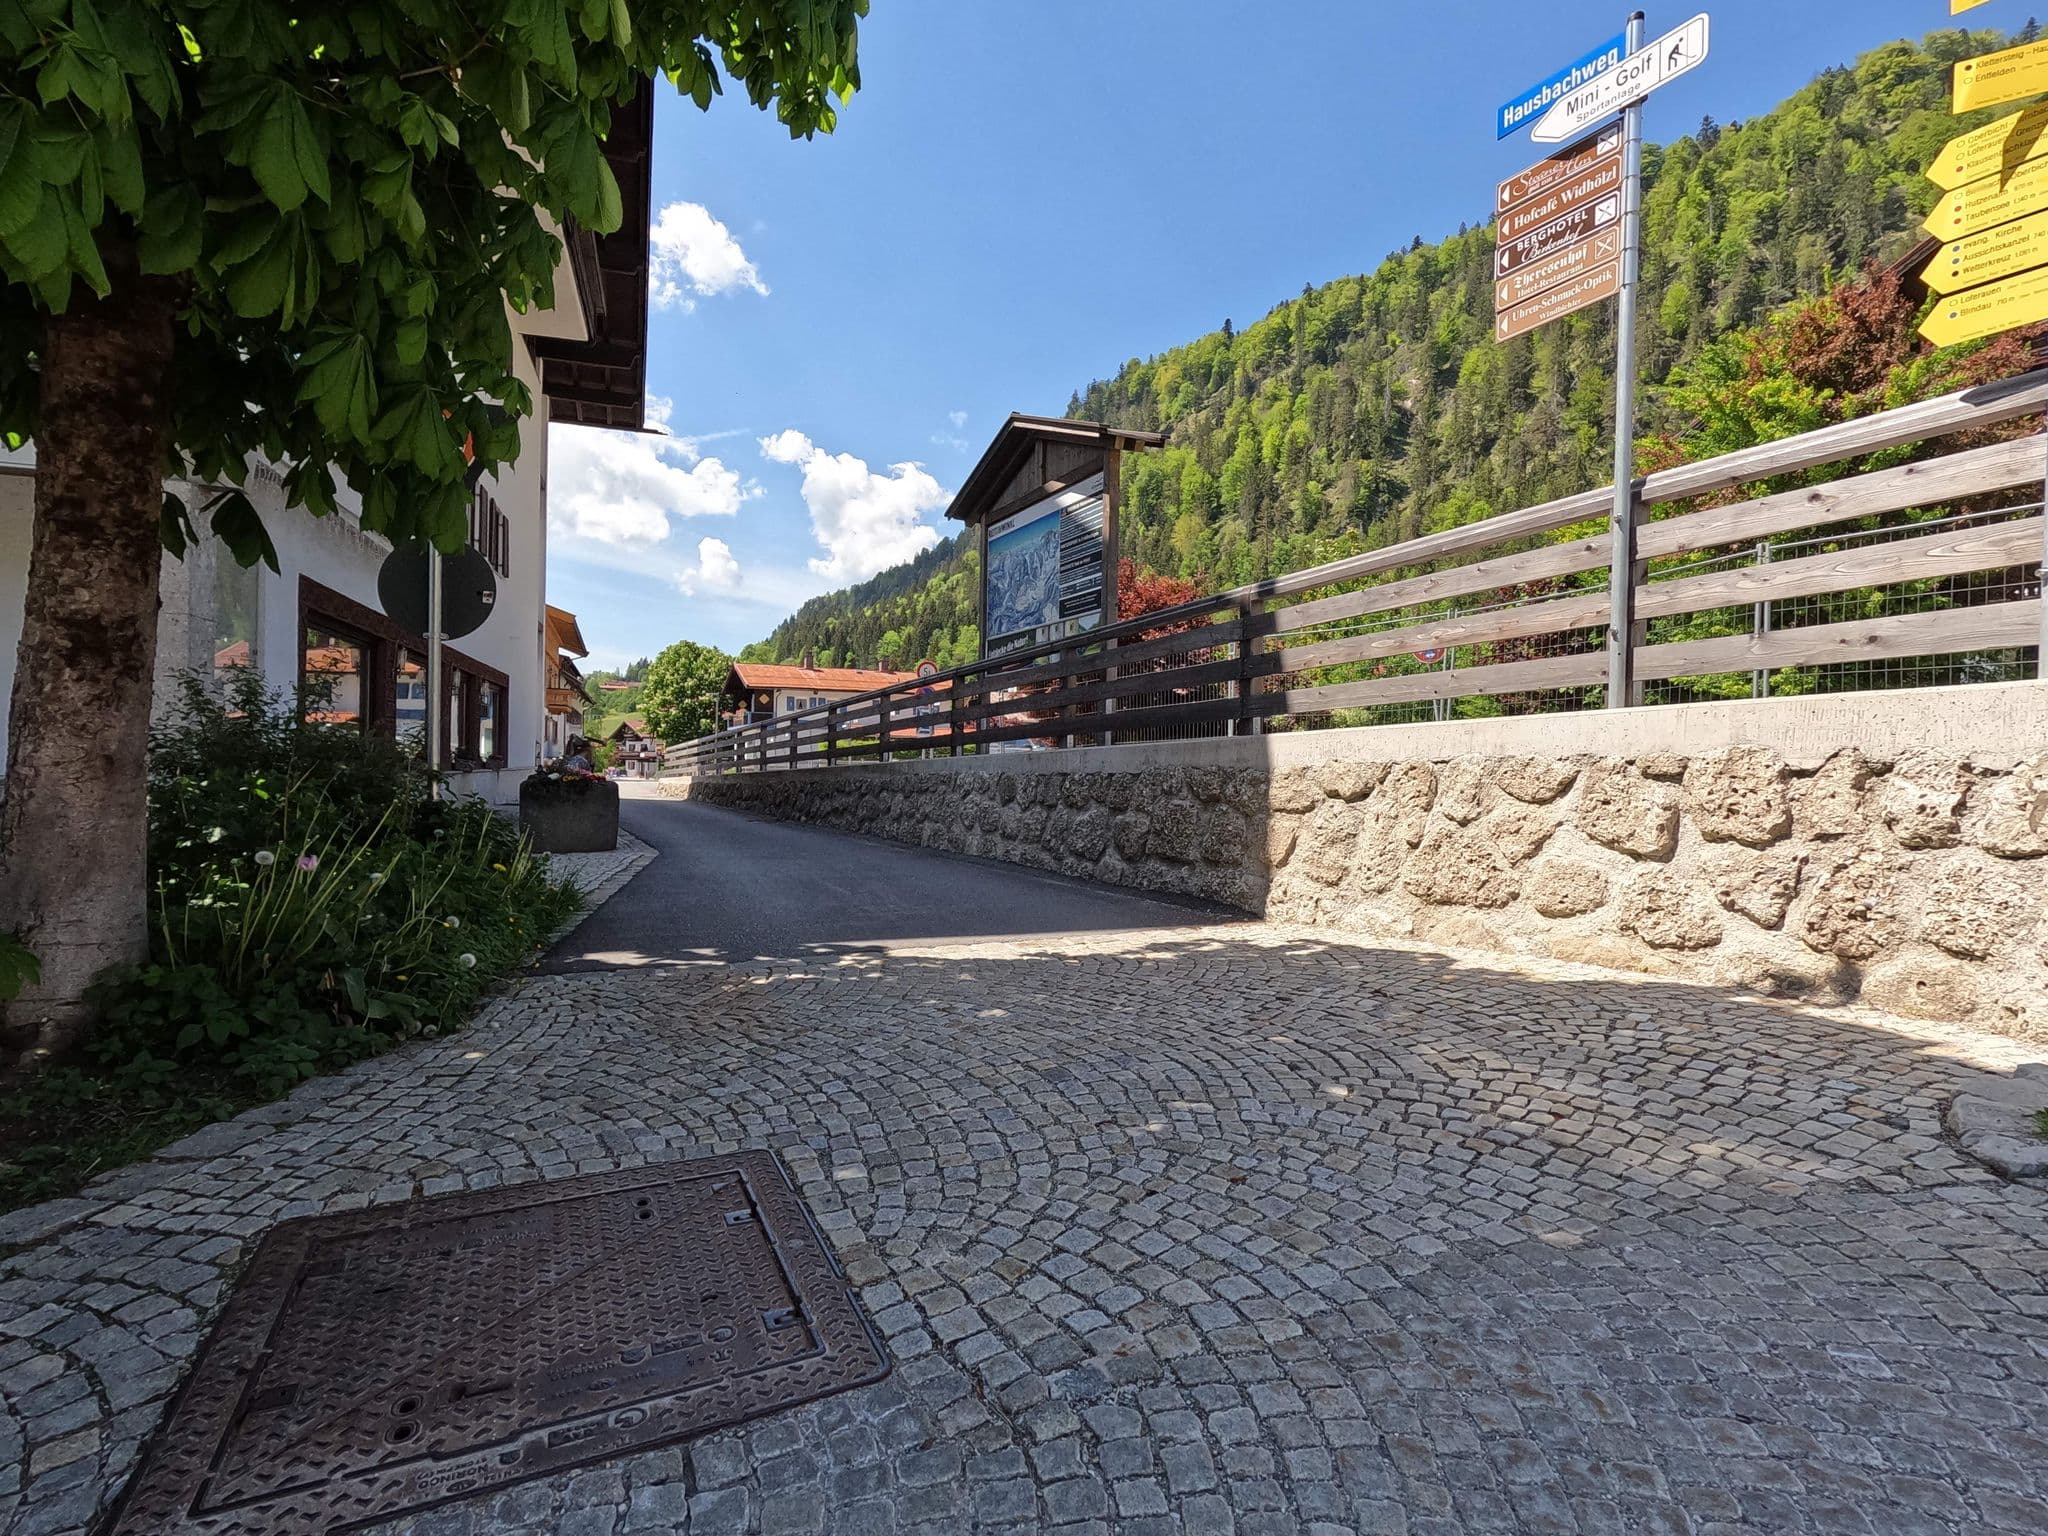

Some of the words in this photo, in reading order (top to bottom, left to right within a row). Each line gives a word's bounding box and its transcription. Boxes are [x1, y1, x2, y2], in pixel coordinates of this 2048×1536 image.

[1503, 47, 1618, 128] Hausbachweg
[1566, 86, 1600, 117] Mini
[1616, 53, 1653, 86] Golf
[1576, 82, 1641, 123] Sportanlage
[1514, 197, 1557, 230] Hofcafé
[1561, 165, 1616, 204] Widhölzl
[1517, 210, 1588, 251] BERGHOTEL
[1995, 225, 2022, 239] Kirche
[1514, 244, 1587, 289] Theresenhof
[1517, 263, 1585, 298] Hotel-Restaurant
[1512, 270, 1613, 322] Uhren-Schmuck-Optik
[418, 1462, 488, 1490] NORINCO
